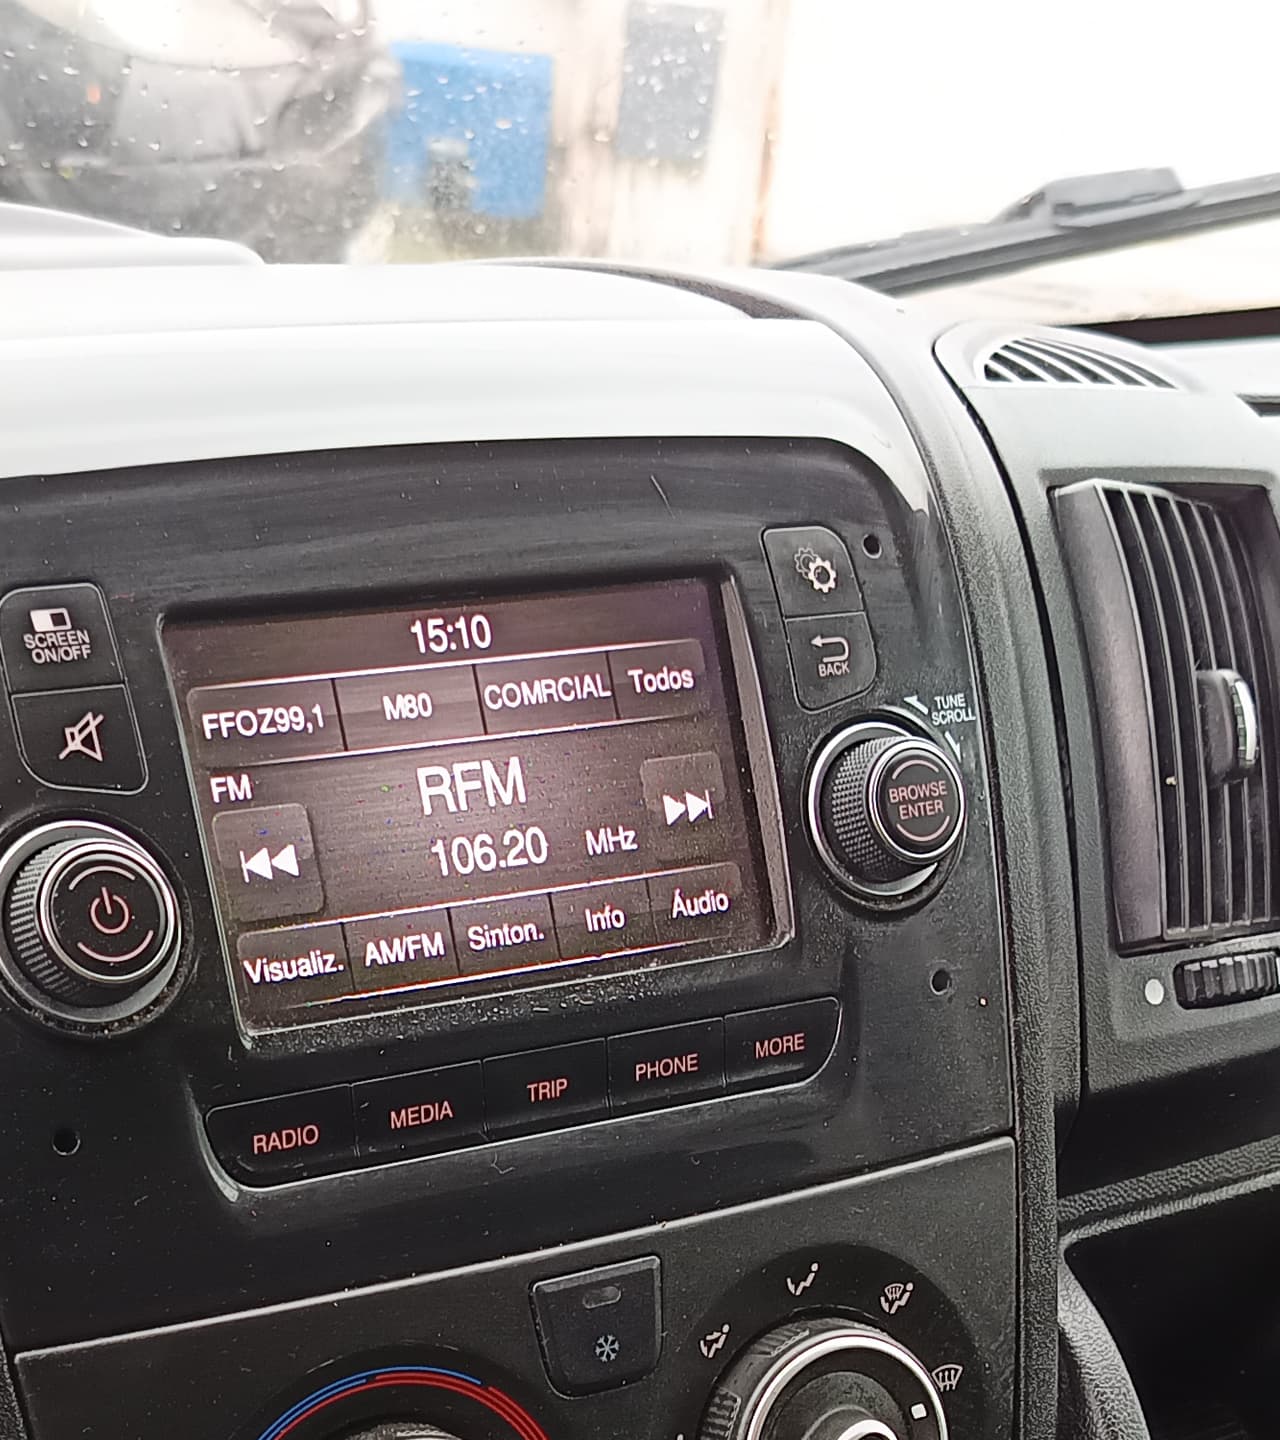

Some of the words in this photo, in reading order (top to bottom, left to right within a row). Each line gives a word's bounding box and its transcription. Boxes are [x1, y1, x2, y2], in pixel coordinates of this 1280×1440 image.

[23, 630, 91, 651] SCREEN
[411, 613, 492, 655] 15:10
[31, 644, 92, 664] ON/OFF
[818, 660, 851, 677] BACK
[484, 673, 612, 711] COMRCIAL
[627, 665, 695, 695] Todos
[382, 692, 433, 721] M80
[931, 706, 976, 726] SCROLL
[934, 694, 966, 709] TUNE
[201, 703, 325, 741] FFOZ99,1
[210, 774, 253, 803] FM
[416, 755, 527, 817] RFM
[888, 779, 948, 804] BROWSE
[898, 799, 945, 821] ENTER
[430, 826, 549, 878] 106.20
[585, 825, 639, 857] MHz
[585, 902, 626, 933] Info
[671, 888, 730, 921] Áudio
[364, 932, 446, 967] AM/FM
[467, 919, 546, 953] Sinton.
[243, 949, 346, 986] Visualiz.
[754, 1031, 806, 1060] MORE
[633, 1052, 700, 1082] PHONE
[526, 1077, 569, 1103] TRIP
[389, 1100, 454, 1131] MEDIA
[251, 1124, 320, 1156] RADIO
